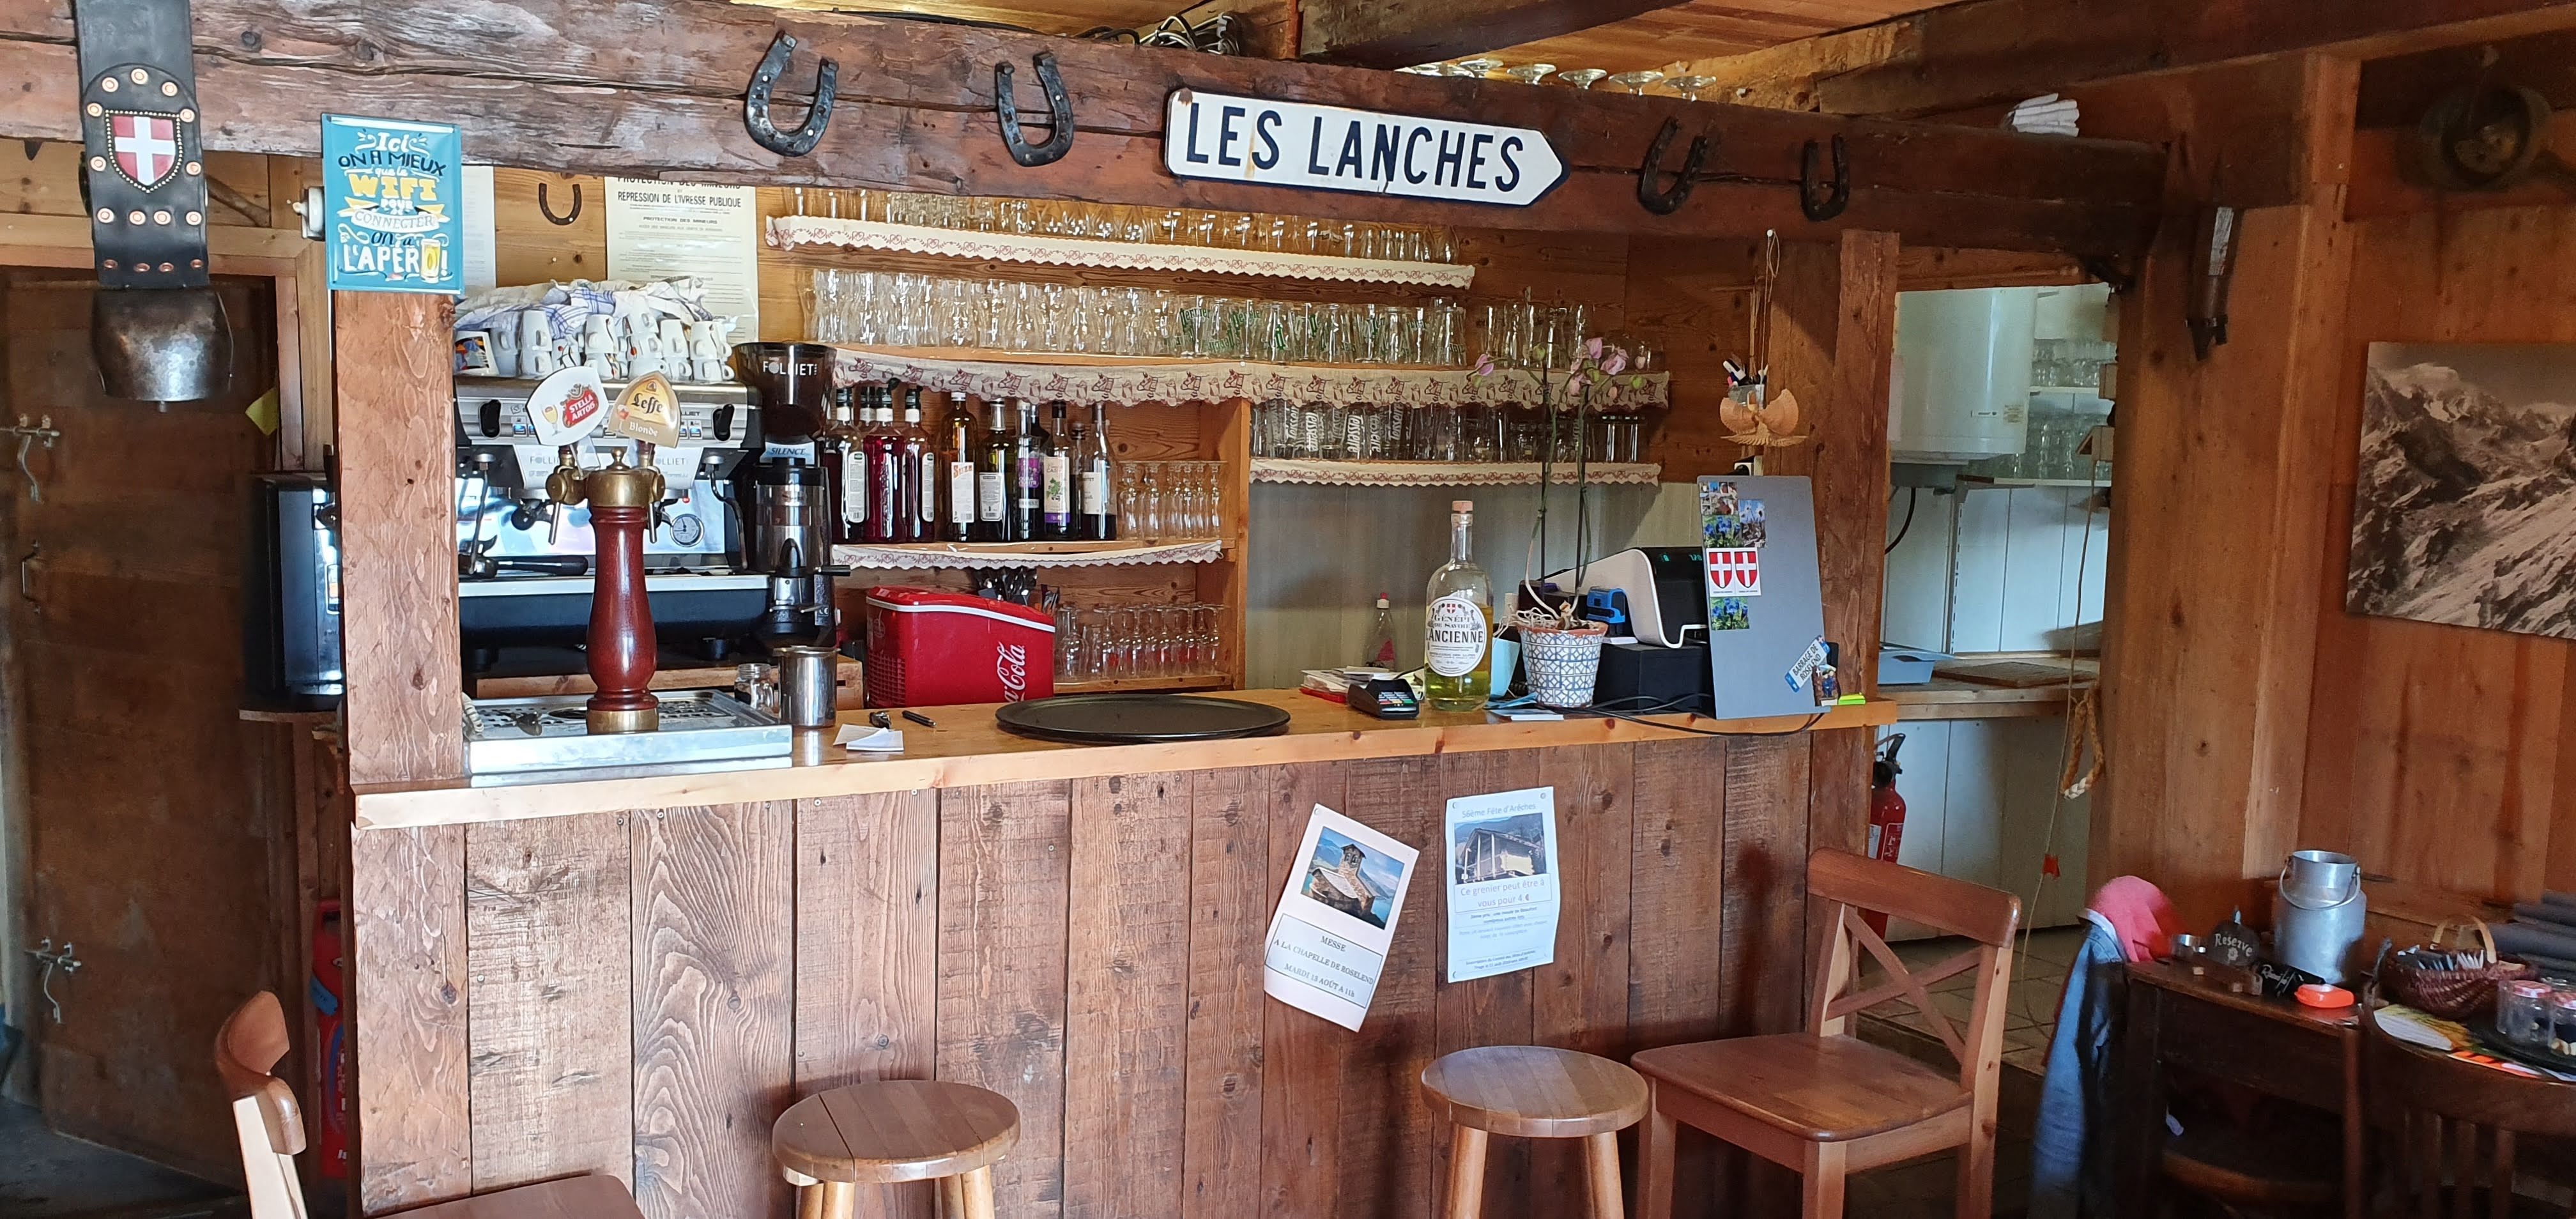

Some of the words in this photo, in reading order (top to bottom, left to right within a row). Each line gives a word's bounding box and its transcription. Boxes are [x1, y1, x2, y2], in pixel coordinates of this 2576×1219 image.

[376, 132, 410, 153] Ici
[1186, 102, 1282, 171] LES
[1308, 116, 1524, 193] LANCHES
[338, 153, 368, 168] ON
[370, 150, 382, 165] A
[388, 152, 447, 177] MIEUX
[348, 173, 438, 201] WIFI
[662, 194, 671, 204] DE
[674, 194, 707, 206] L'IVRESSE
[709, 196, 742, 208] PUBLIQUE
[354, 209, 435, 229] CONNECTER
[569, 394, 594, 413] STELLA
[631, 392, 663, 415] Leffe
[629, 421, 659, 438] Blonde
[770, 447, 806, 456] SILENCE
[1791, 649, 1813, 677] BARRAGE
[1810, 643, 1819, 653] DE
[1460, 887, 1471, 896] Ce
[1473, 884, 1501, 896] grenier
[1503, 882, 1521, 894] peut
[1498, 896, 1515, 907] pour
[1320, 935, 1347, 952] MESSE
[1280, 940, 1291, 951] LA
[1292, 946, 1330, 966] CHAPELLE
[1330, 960, 1340, 970] DE
[1341, 965, 1374, 985] ROSELEND
[1284, 963, 1310, 979] MARDI
[1344, 988, 1355, 997] 11h
